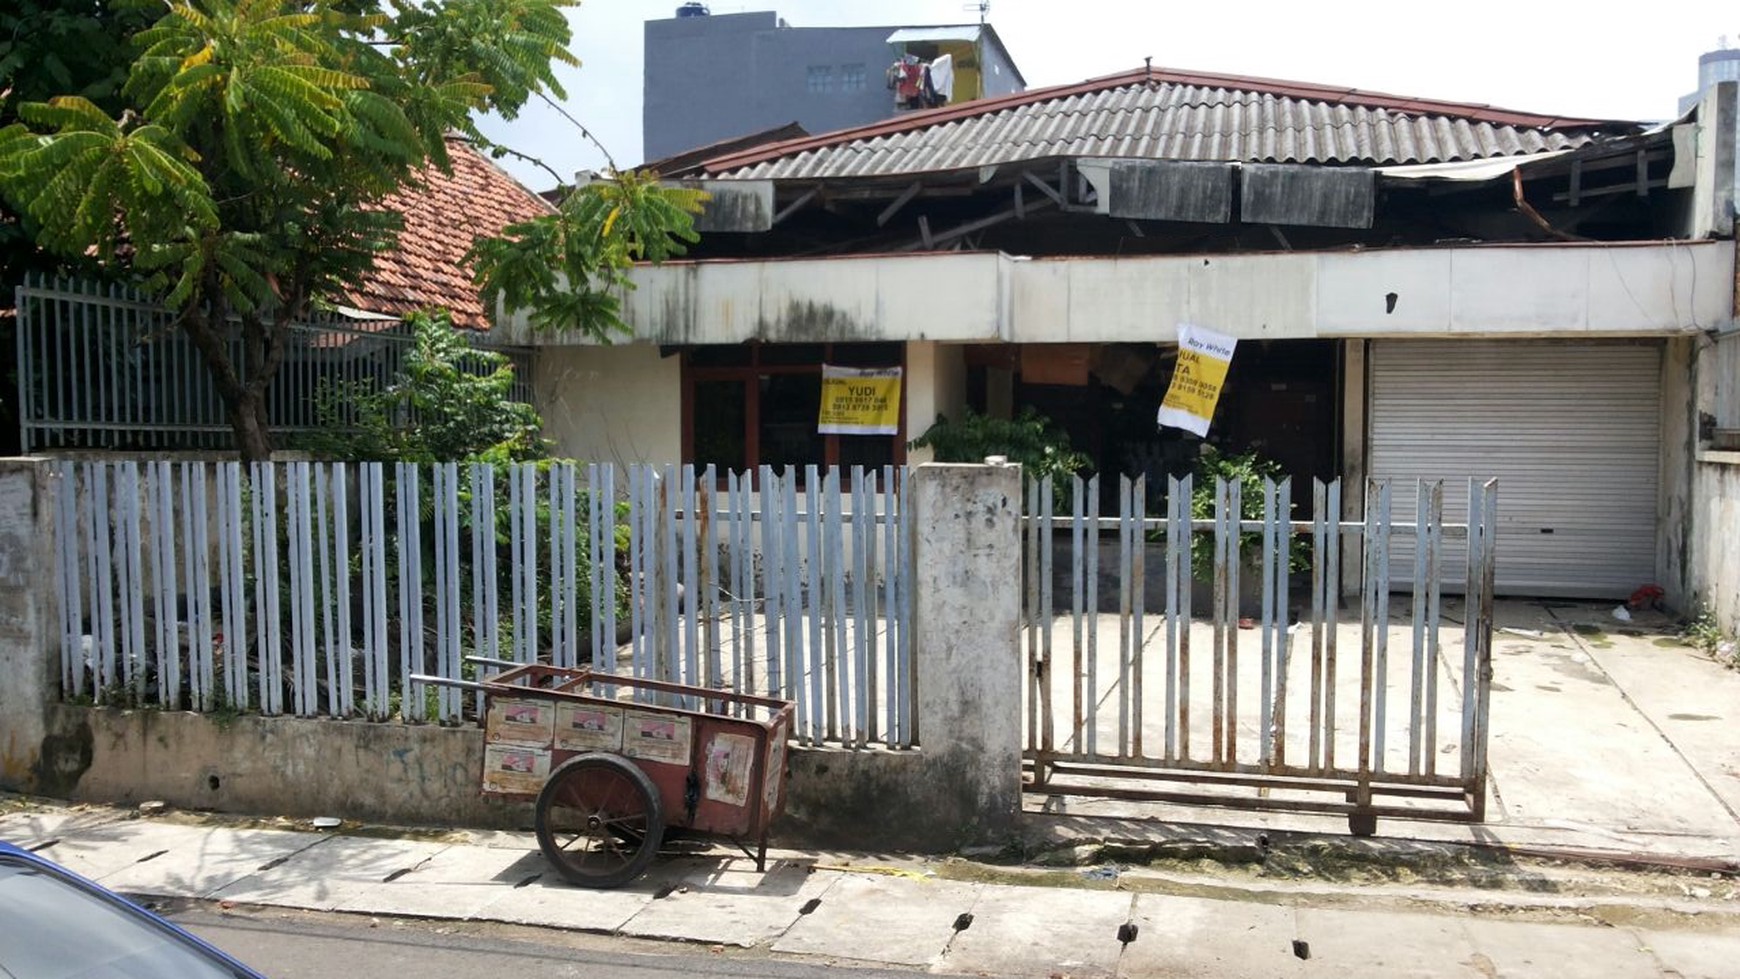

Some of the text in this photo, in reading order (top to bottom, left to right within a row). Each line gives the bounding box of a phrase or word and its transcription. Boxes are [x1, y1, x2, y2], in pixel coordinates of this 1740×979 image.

[1188, 338, 1231, 356] Ray White
[848, 386, 875, 396] YUDI
